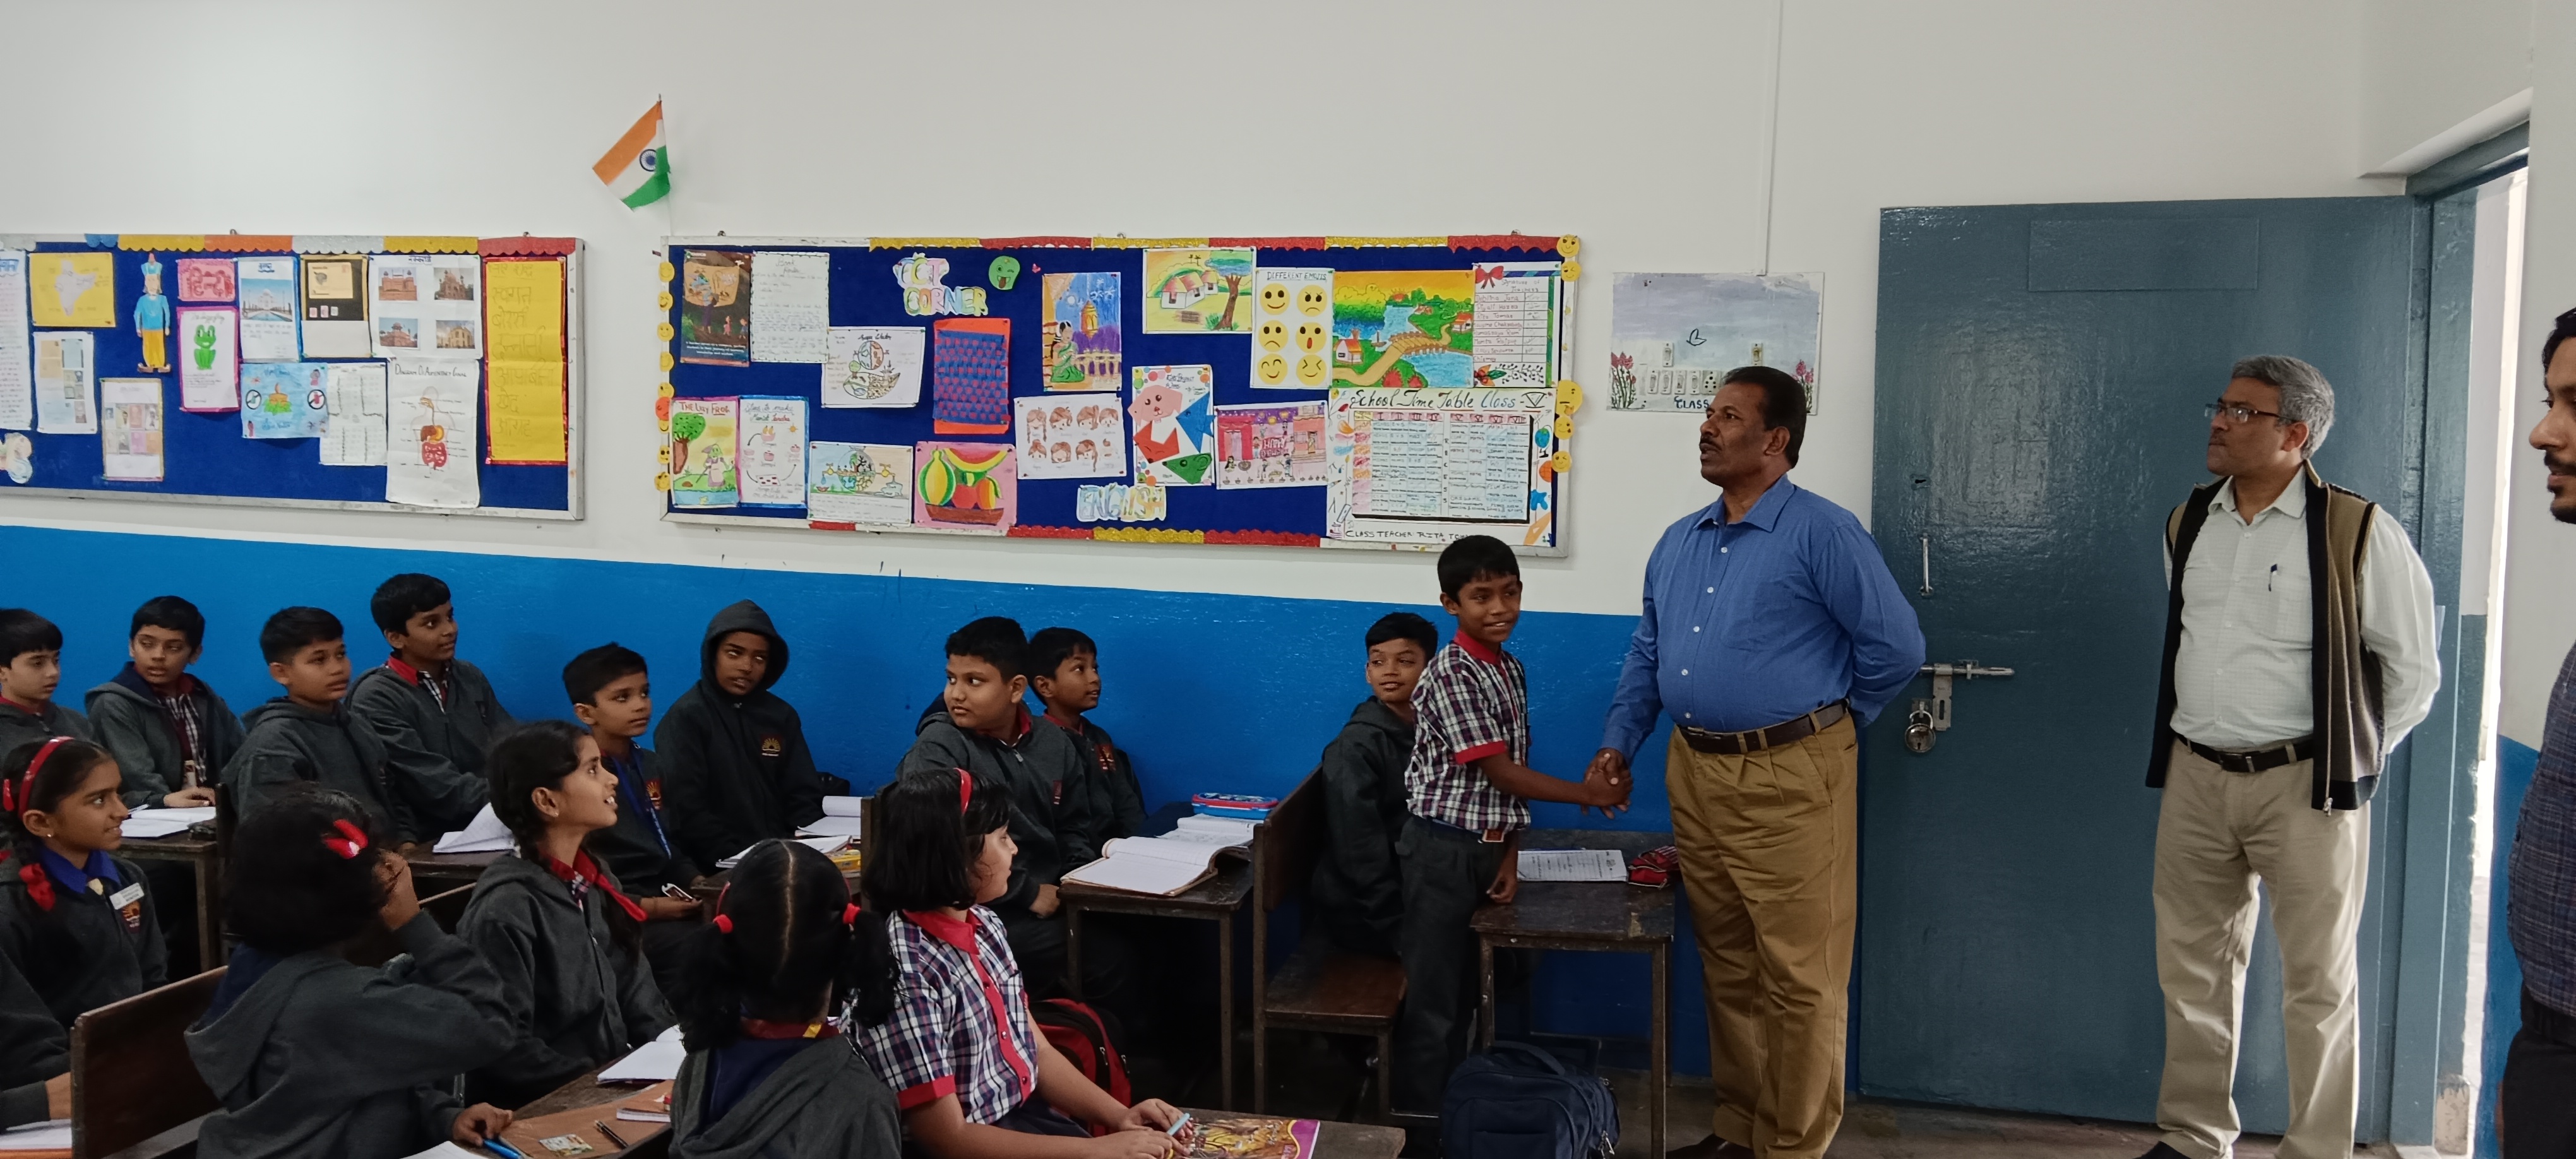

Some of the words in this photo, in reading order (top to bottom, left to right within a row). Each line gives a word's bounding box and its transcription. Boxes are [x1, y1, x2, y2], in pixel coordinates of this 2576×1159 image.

[1267, 271, 1303, 280] DIFFERENT
[1304, 272, 1327, 280] EMOJIS
[904, 287, 988, 316] CORNER
[1349, 388, 1395, 408] School
[1397, 389, 1434, 408] Time
[1437, 391, 1473, 408] Table
[1481, 389, 1515, 408] Class
